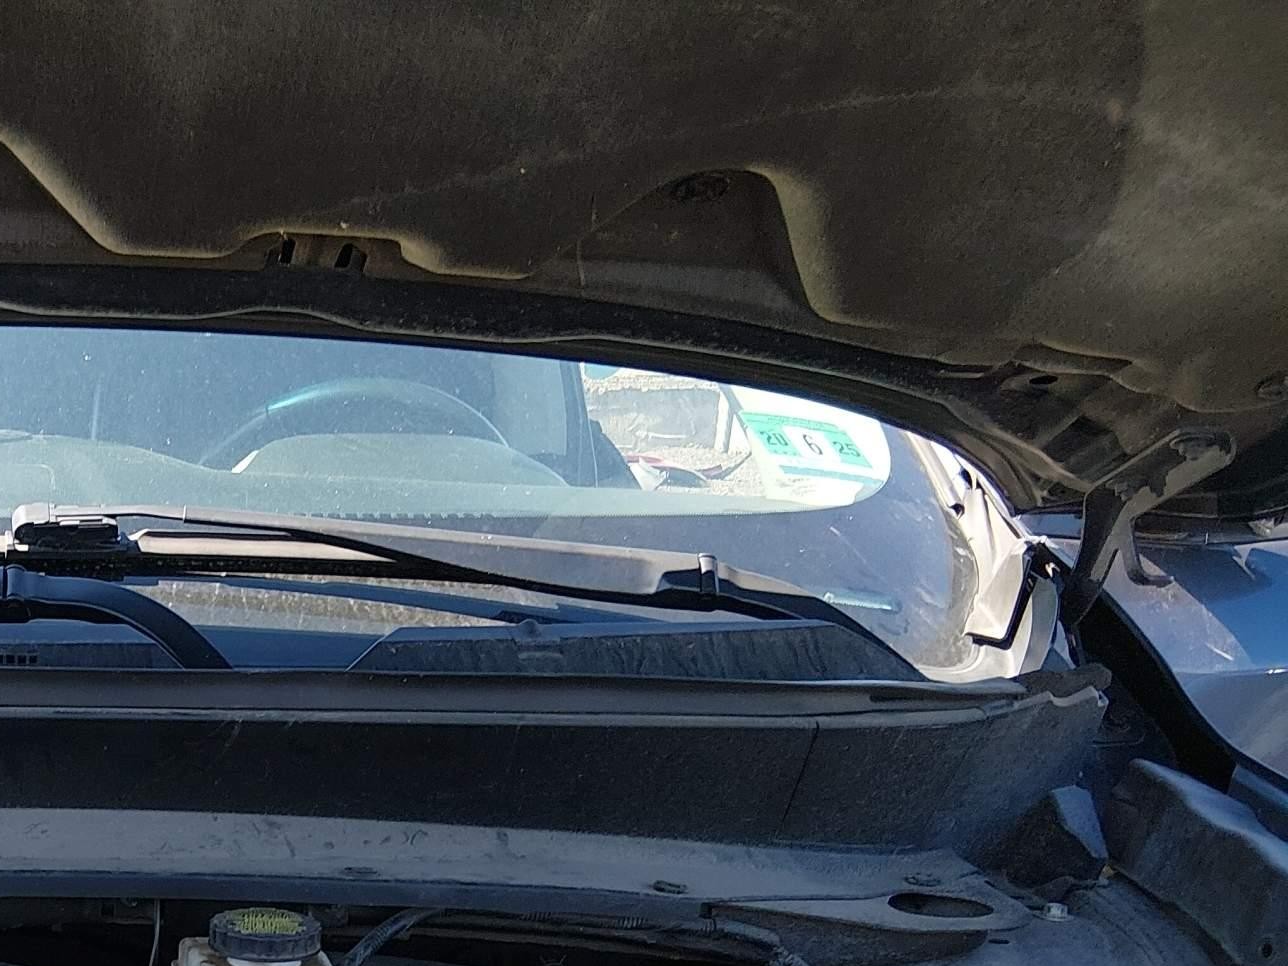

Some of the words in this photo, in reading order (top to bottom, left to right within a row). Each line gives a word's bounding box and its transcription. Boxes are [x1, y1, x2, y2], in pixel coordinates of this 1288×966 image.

[759, 430, 789, 447] 20
[801, 433, 824, 456] 6
[831, 440, 862, 458] 25
